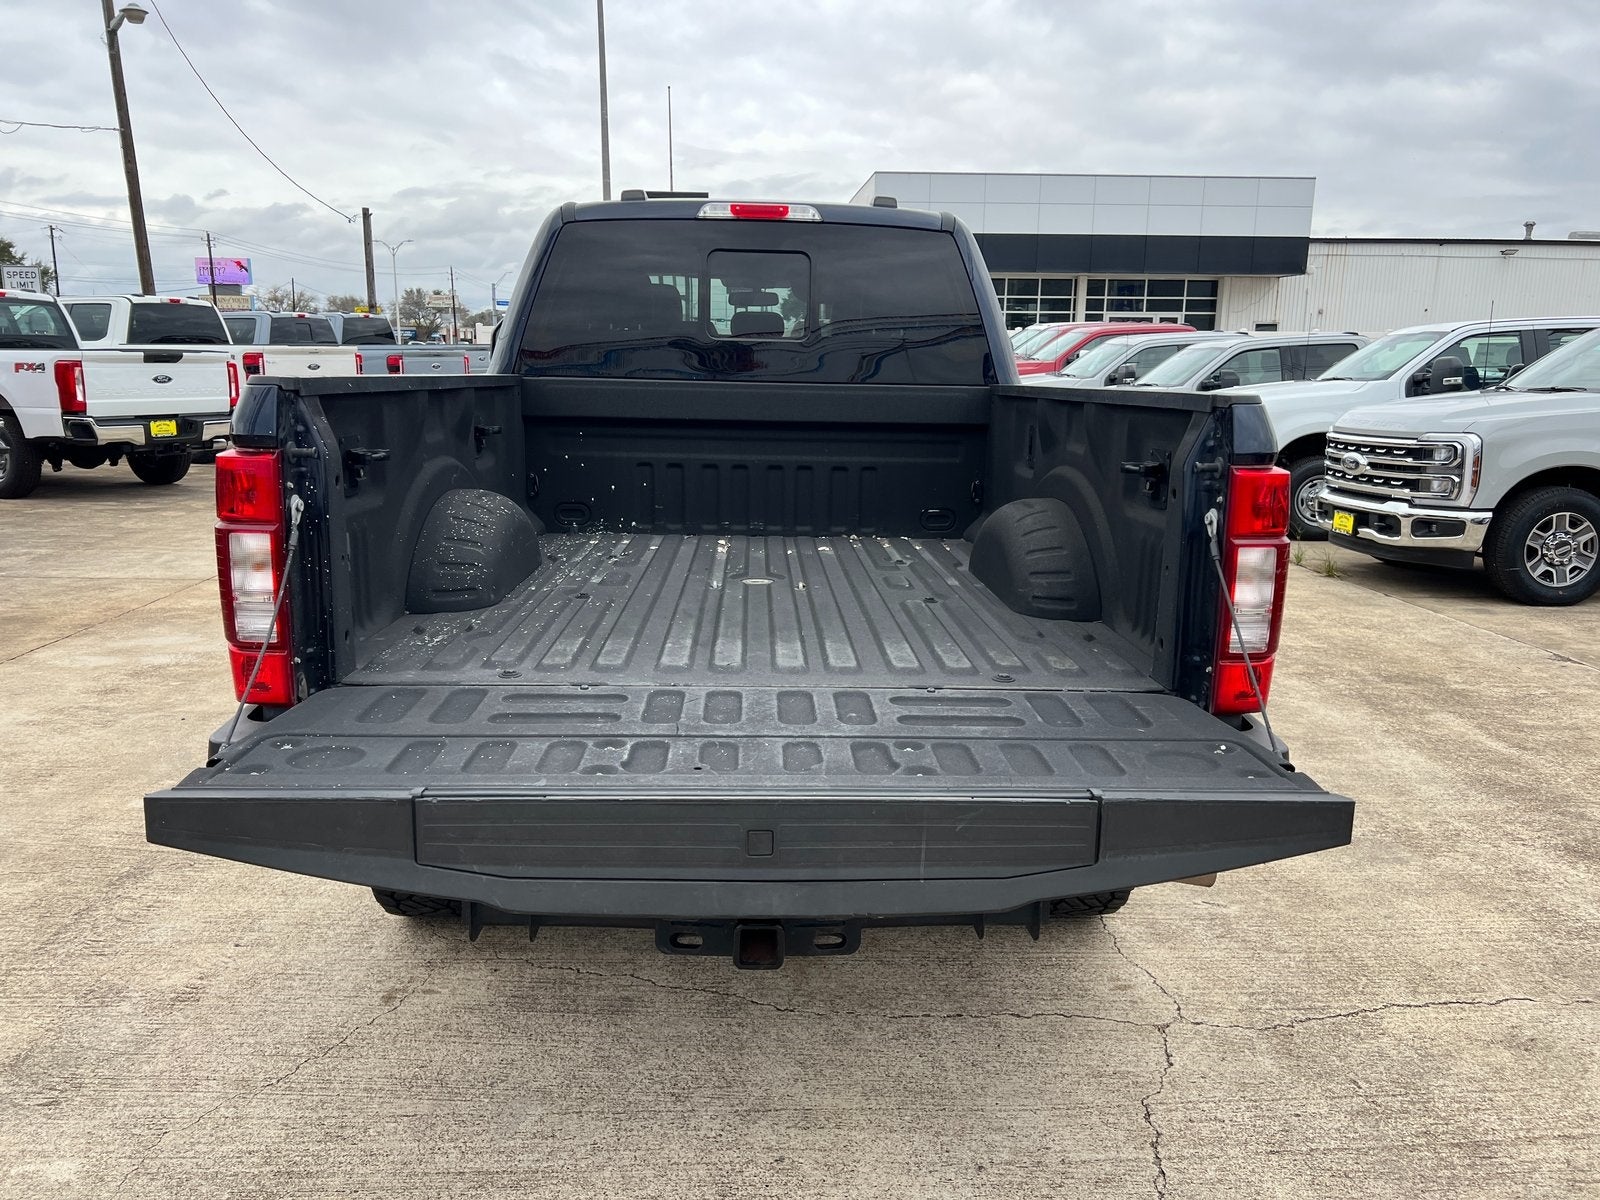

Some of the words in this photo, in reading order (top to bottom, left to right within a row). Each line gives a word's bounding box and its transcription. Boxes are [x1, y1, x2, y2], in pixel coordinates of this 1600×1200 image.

[6, 271, 37, 279] SPEED
[199, 266, 226, 276] EMTY?
[10, 281, 34, 289] LIMIT
[14, 362, 46, 373] FX4
